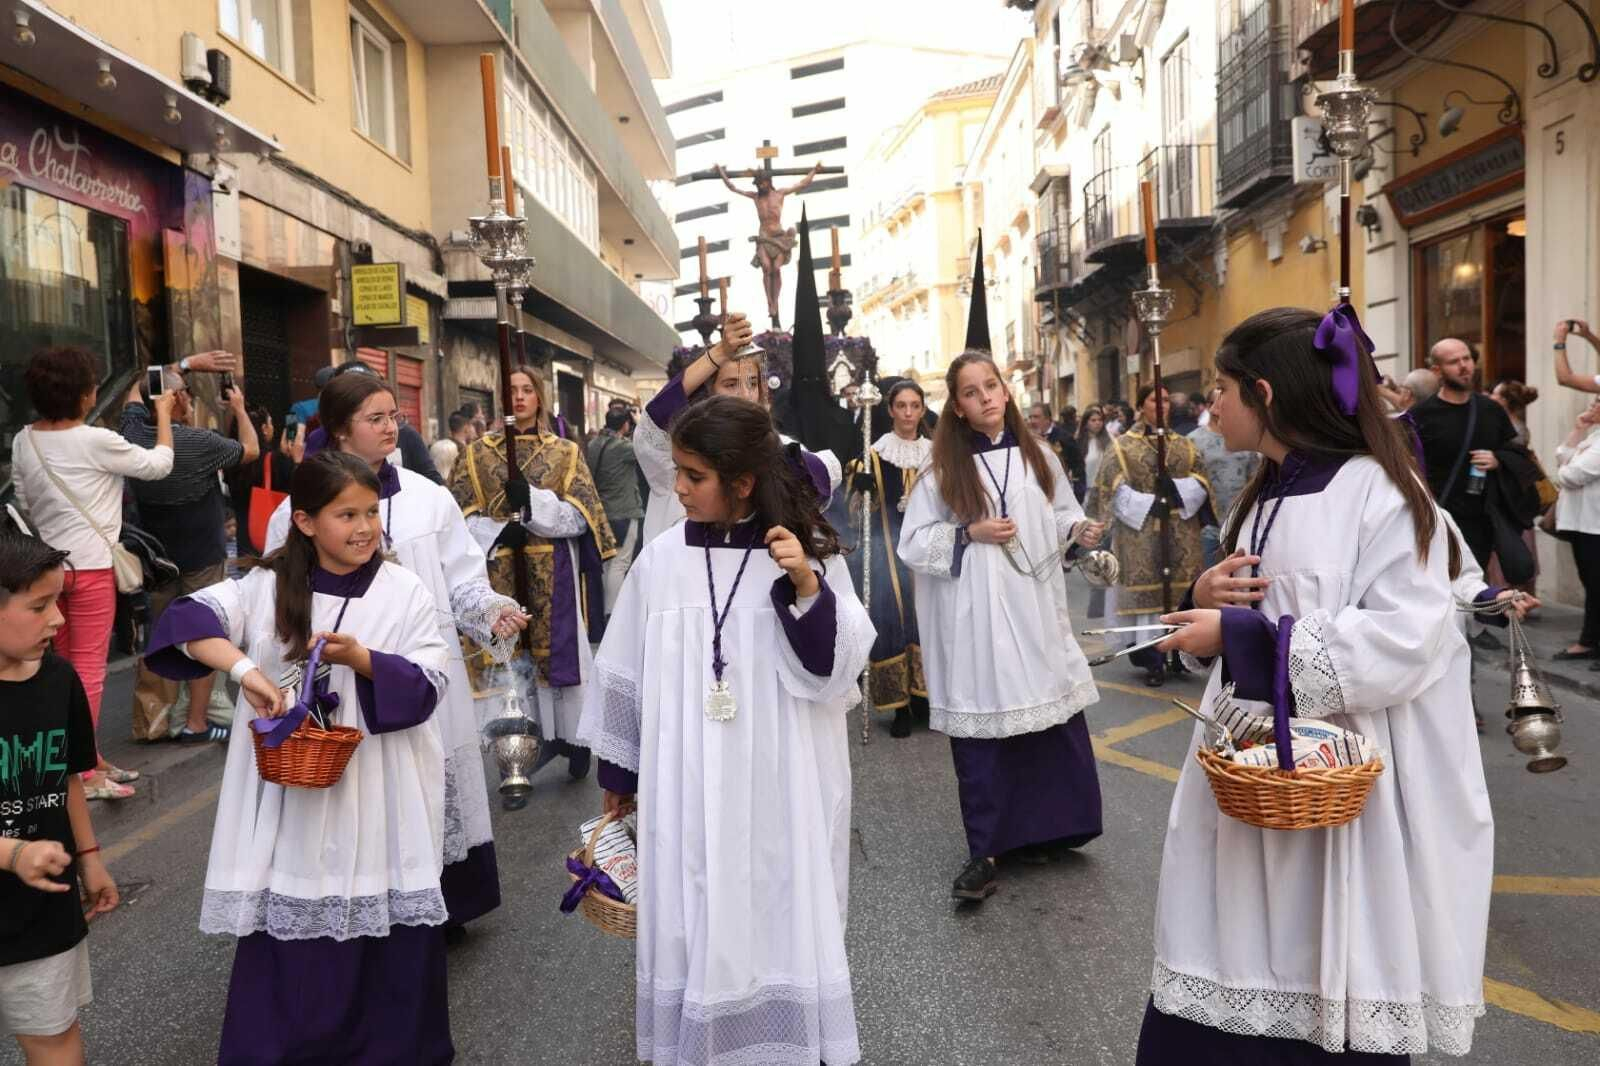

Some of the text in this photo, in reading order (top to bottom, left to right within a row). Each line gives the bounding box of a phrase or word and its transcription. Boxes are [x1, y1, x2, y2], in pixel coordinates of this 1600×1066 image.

[1554, 130, 1566, 155] 5
[0, 728, 67, 782] AME
[0, 792, 67, 816] SS START
